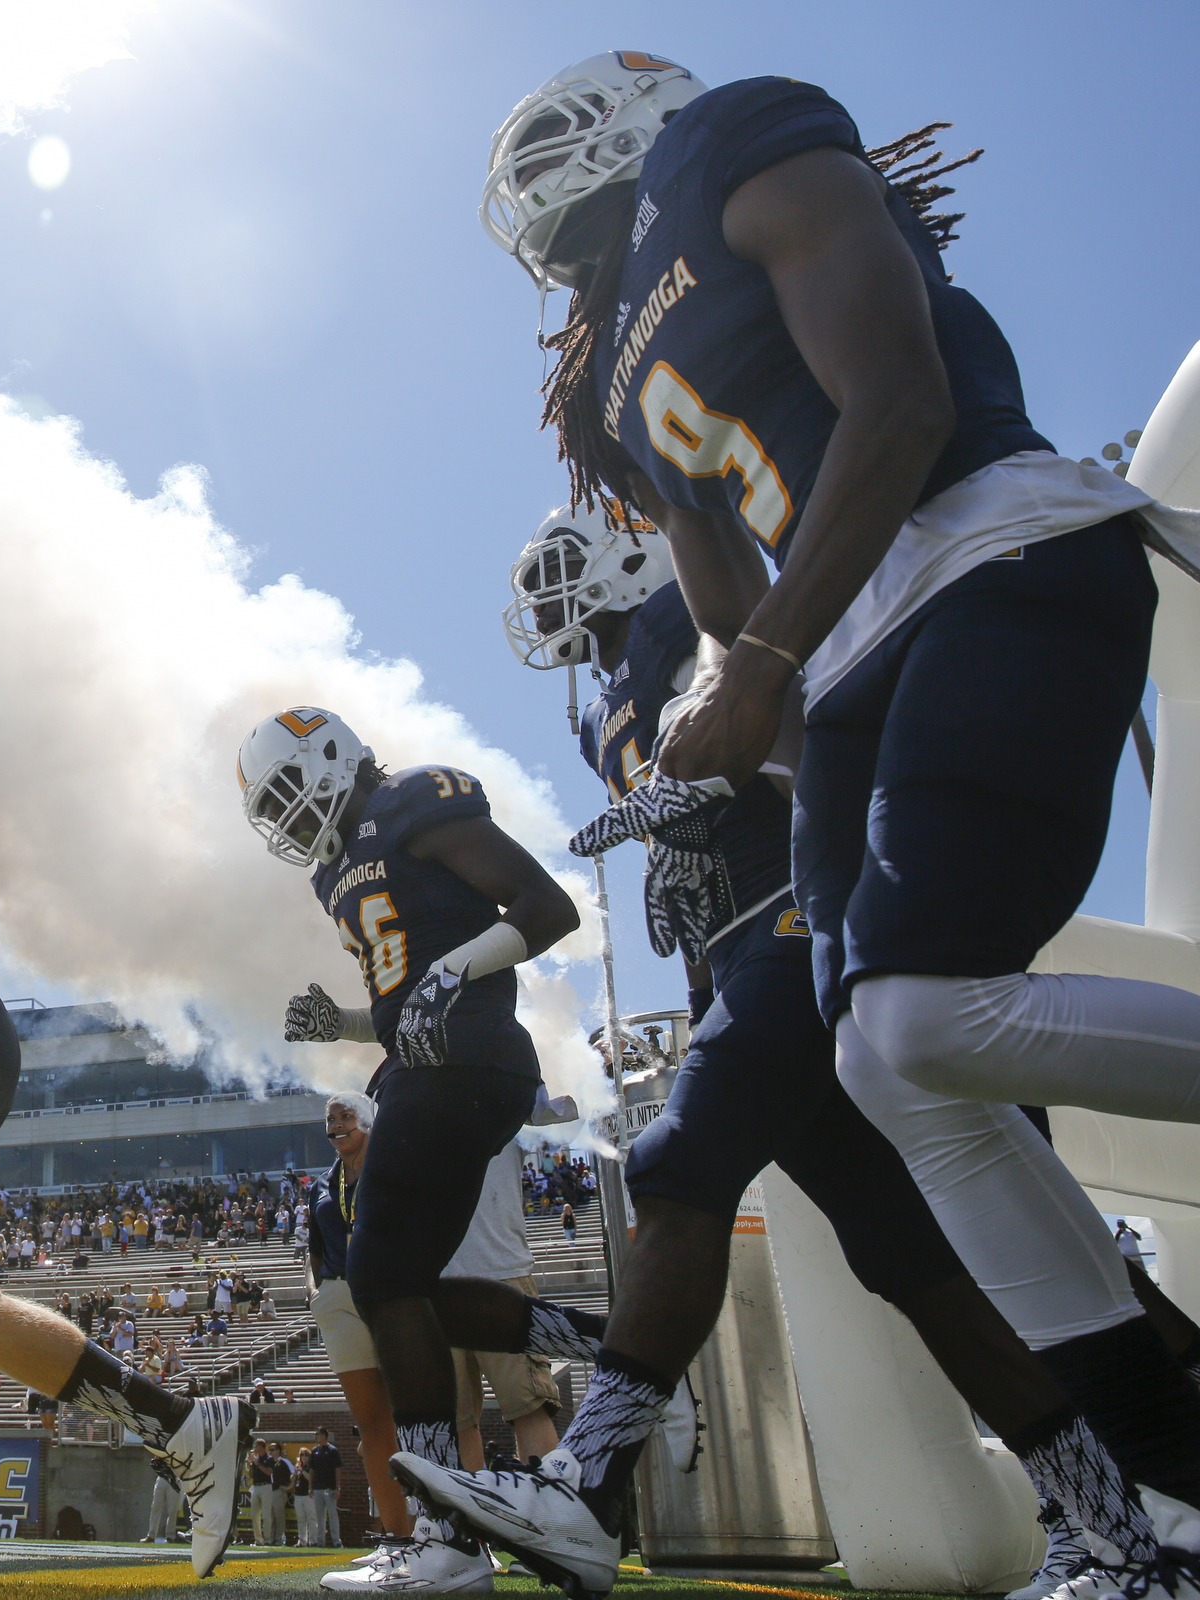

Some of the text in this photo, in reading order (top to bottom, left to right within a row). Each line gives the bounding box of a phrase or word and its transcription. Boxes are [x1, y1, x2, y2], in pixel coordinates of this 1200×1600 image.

[604, 256, 698, 442] CHATTANOOGA
[638, 360, 794, 548] 9
[428, 769, 473, 798] 36
[328, 860, 387, 916] ATTANOOGA
[734, 1220, 764, 1228] pply.net
